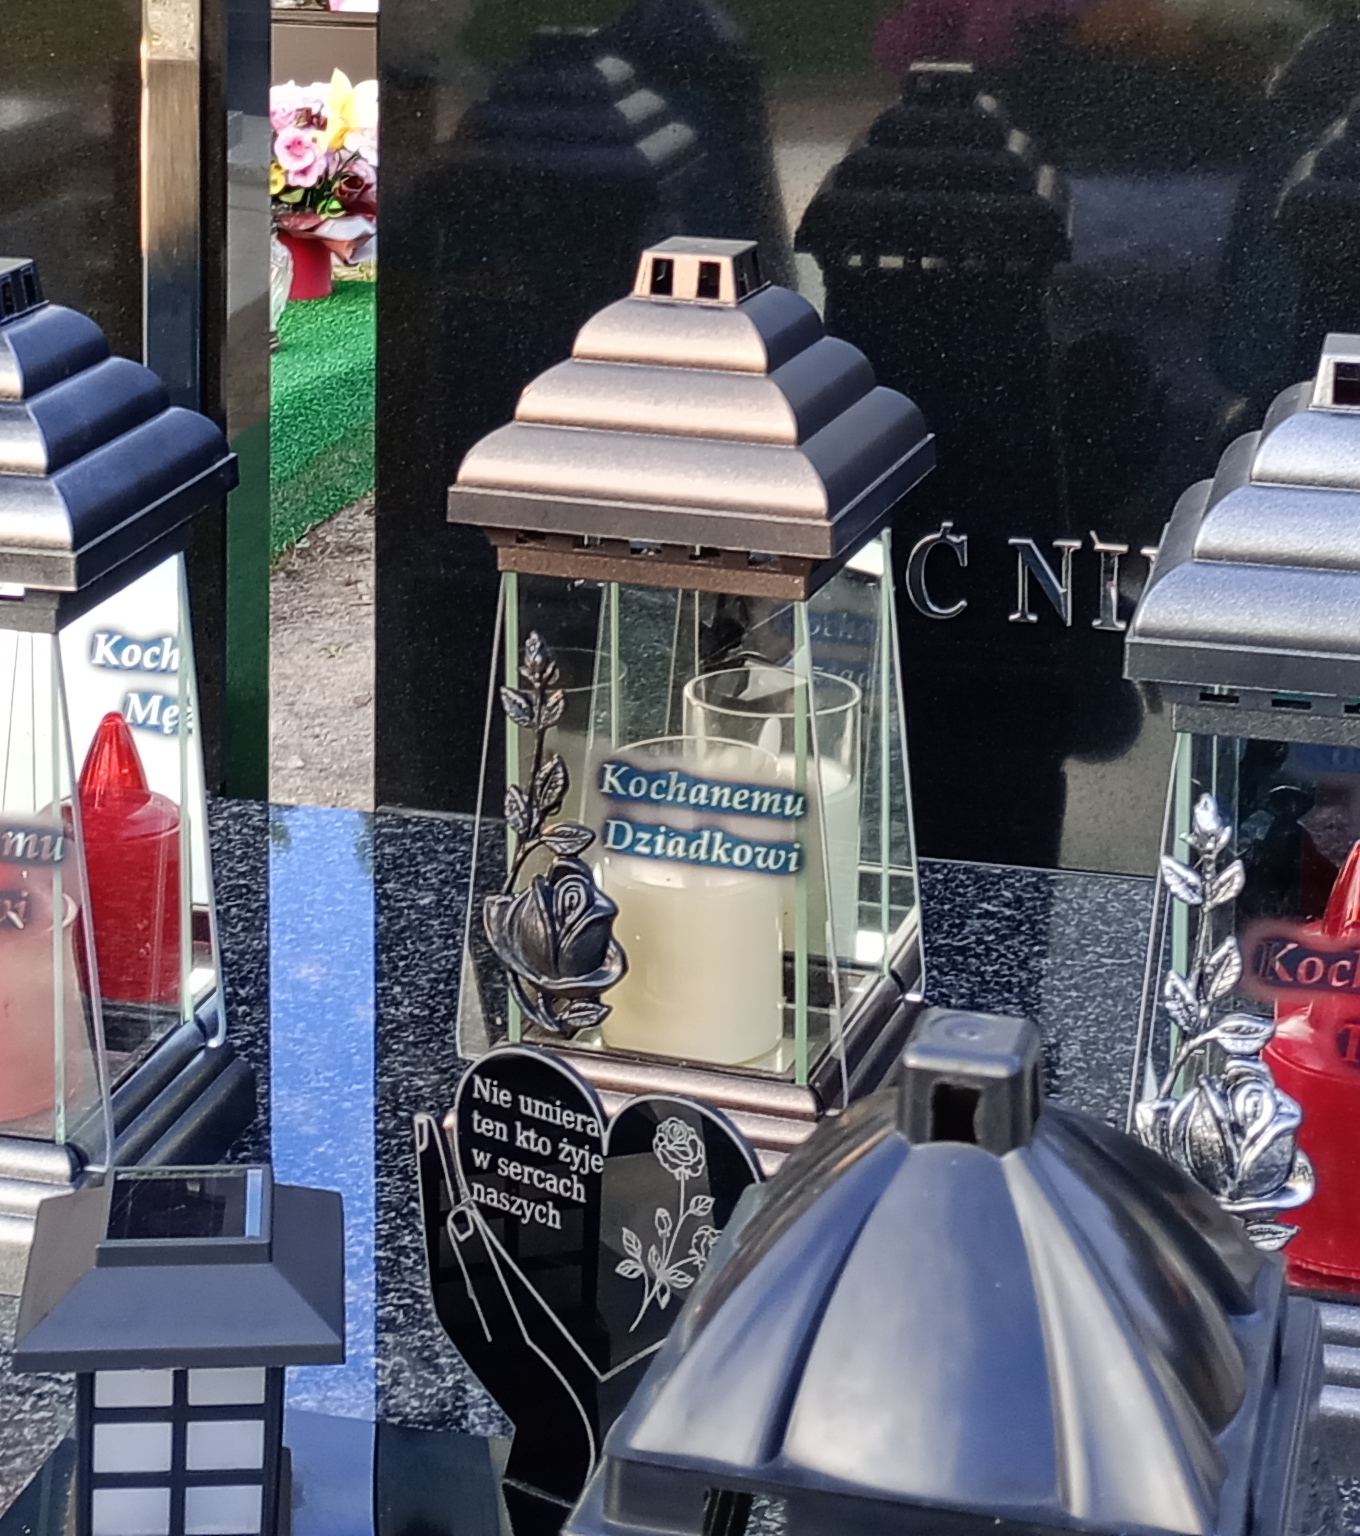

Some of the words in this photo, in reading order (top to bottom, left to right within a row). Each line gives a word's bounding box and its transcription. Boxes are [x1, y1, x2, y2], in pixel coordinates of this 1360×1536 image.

[600, 763, 806, 818] Kochanemu
[603, 818, 801, 872] Dziadkowi
[471, 1074, 513, 1109] Nie
[517, 1095, 601, 1138] umiera
[471, 1109, 509, 1143] ten
[514, 1120, 552, 1157] kto
[557, 1137, 605, 1176] żyje
[470, 1148, 493, 1171] w
[497, 1156, 587, 1204] sercach
[470, 1181, 562, 1231] naszych
